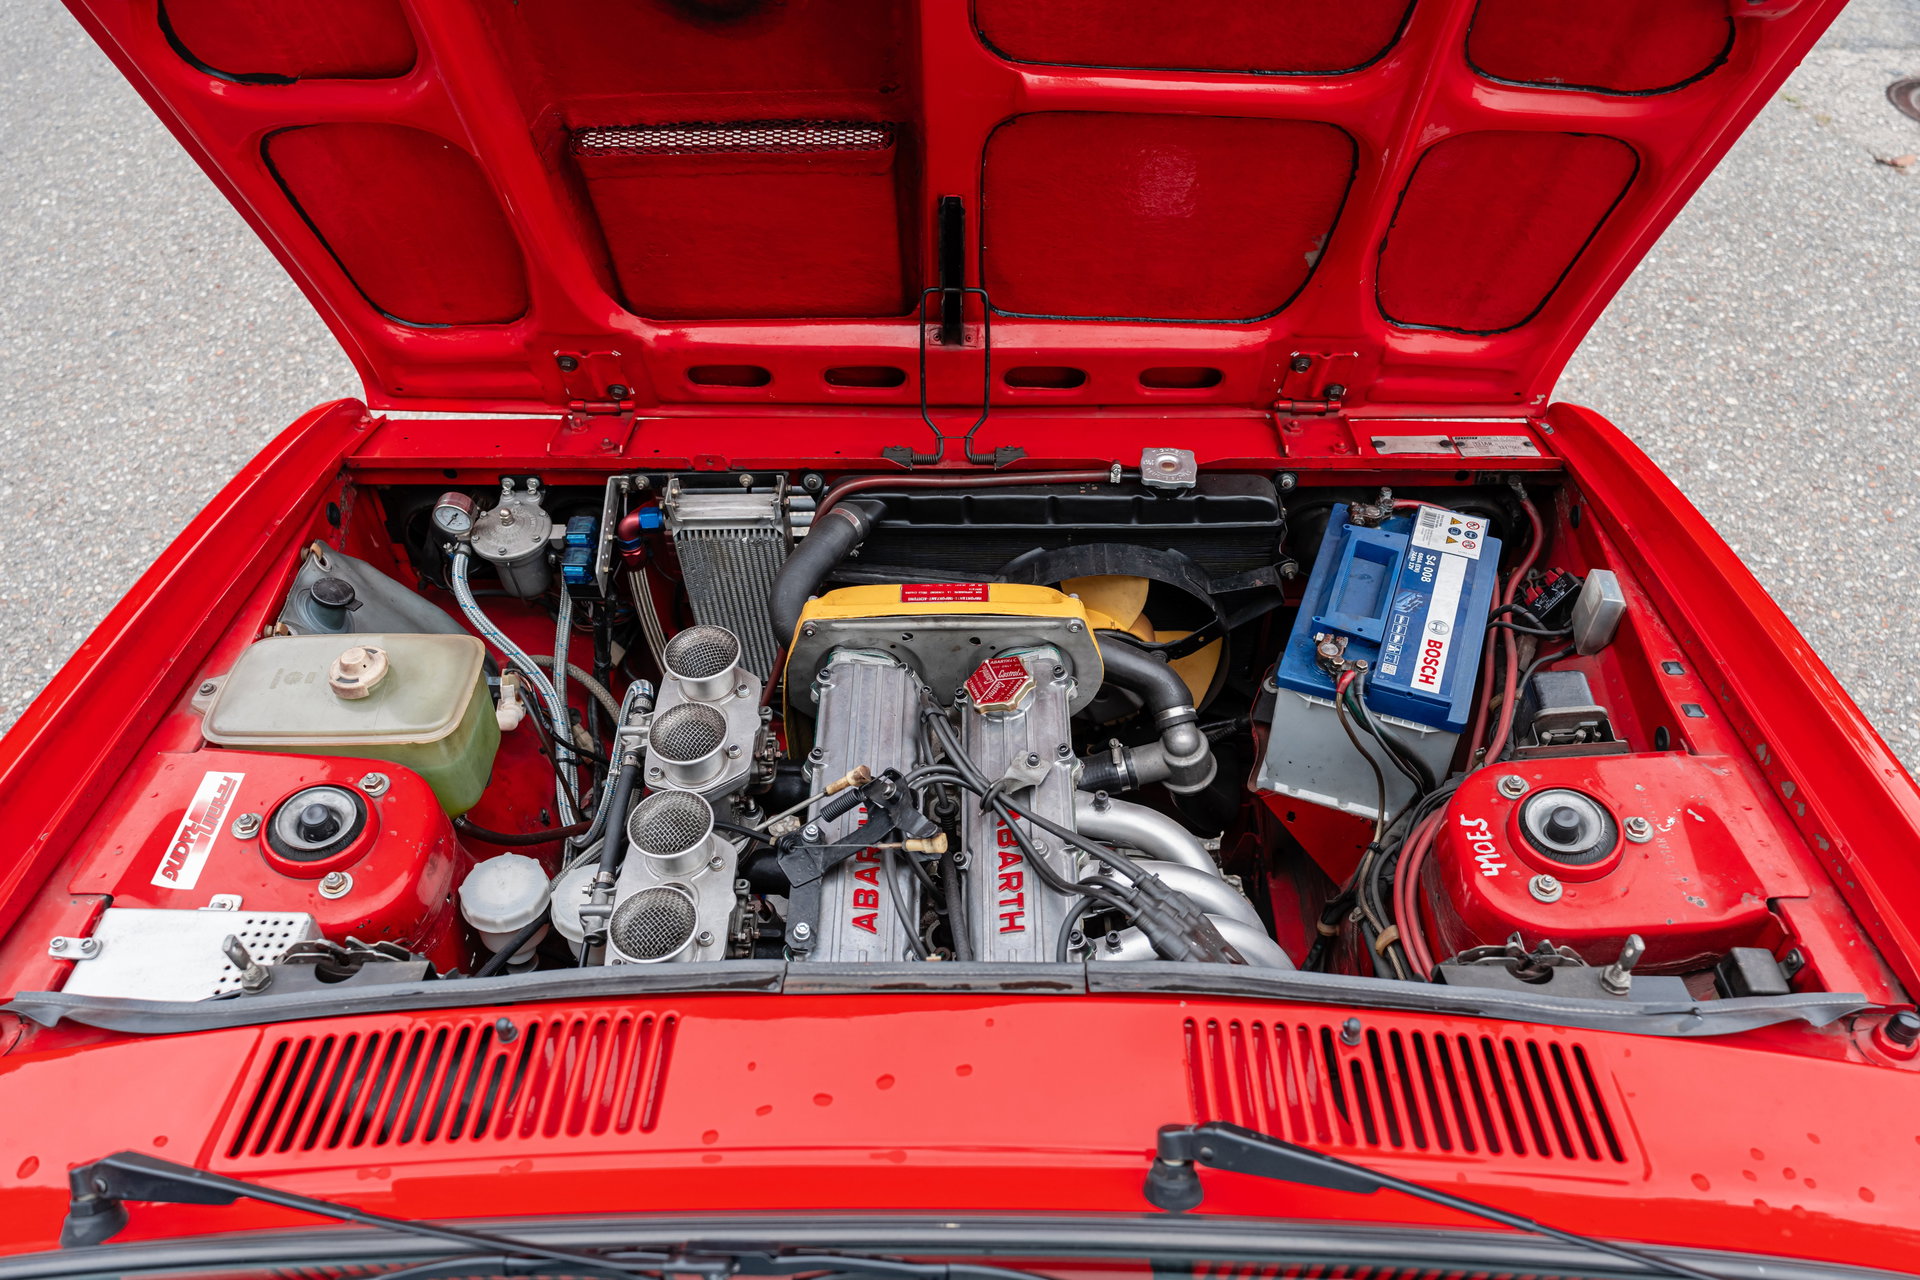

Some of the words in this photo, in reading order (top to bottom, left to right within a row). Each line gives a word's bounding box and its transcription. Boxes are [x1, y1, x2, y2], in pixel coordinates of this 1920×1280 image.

[1421, 567, 1434, 583] 008
[1425, 555, 1437, 566] S4
[1418, 639, 1443, 685] BOSCH
[161, 822, 201, 882] RACING
